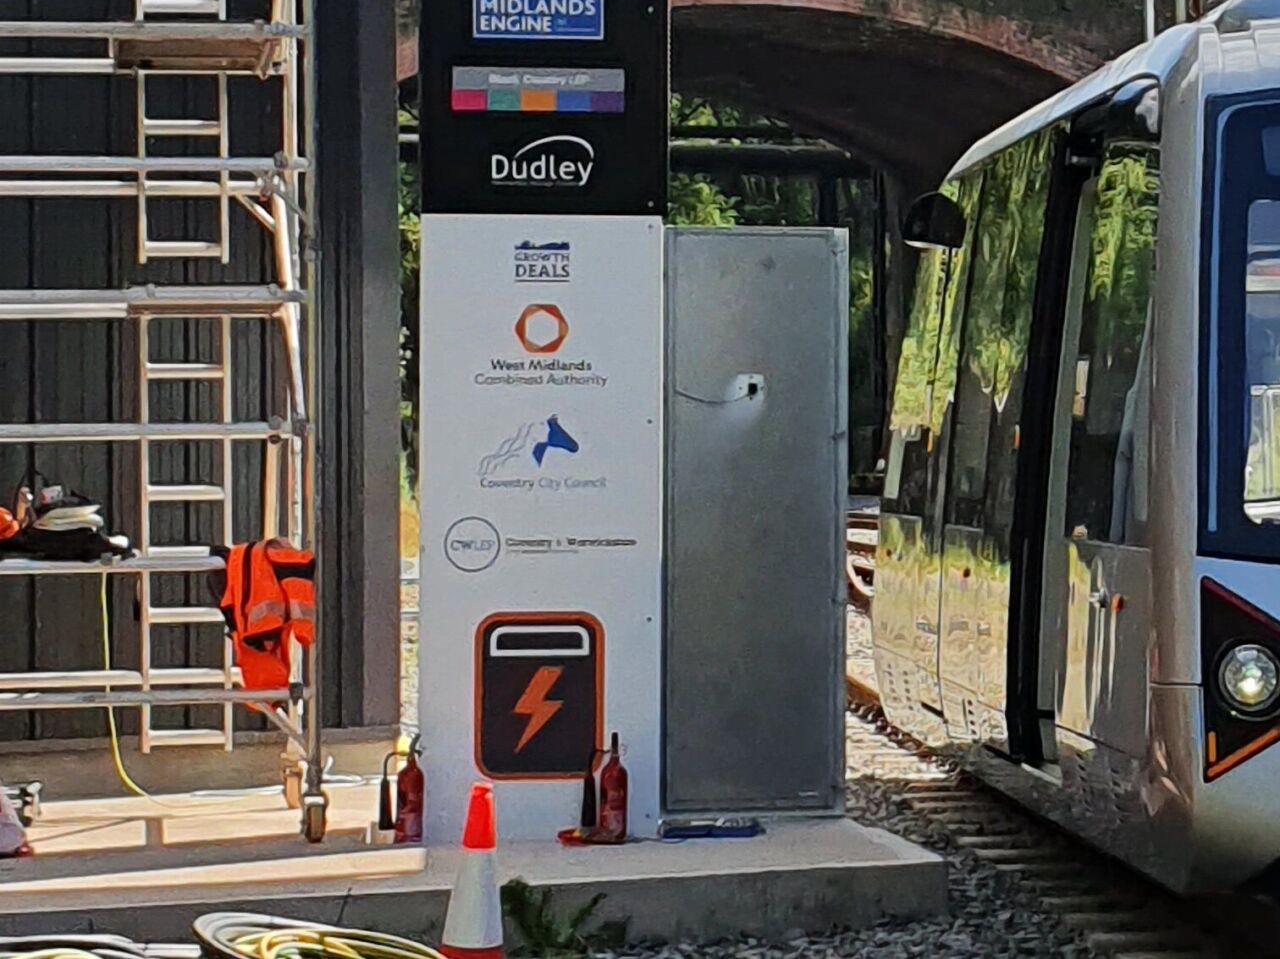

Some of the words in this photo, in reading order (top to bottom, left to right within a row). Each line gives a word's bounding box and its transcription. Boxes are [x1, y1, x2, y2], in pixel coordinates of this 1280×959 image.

[480, 15, 553, 32] ENGINE
[491, 154, 594, 187] Dudley
[514, 252, 570, 263] GROWTH
[515, 264, 570, 278] DEALS
[491, 359, 525, 372] West
[528, 359, 592, 372] Midlands
[474, 373, 543, 386] Combined
[546, 373, 608, 388] Authority
